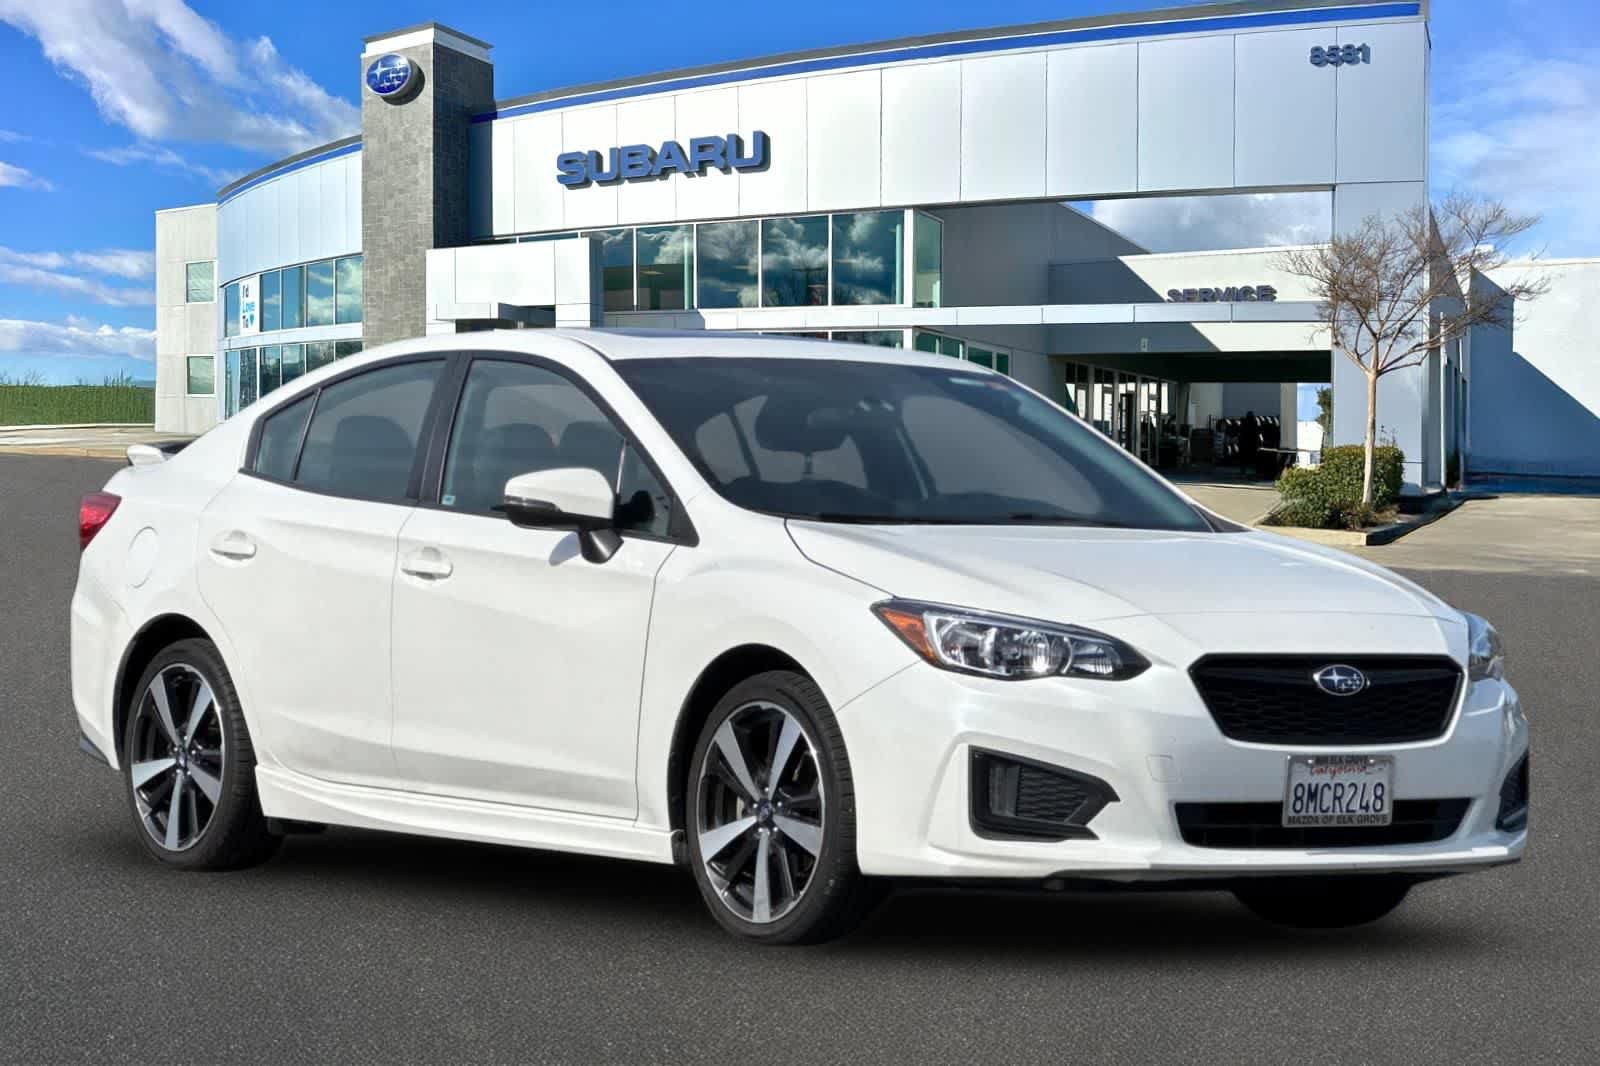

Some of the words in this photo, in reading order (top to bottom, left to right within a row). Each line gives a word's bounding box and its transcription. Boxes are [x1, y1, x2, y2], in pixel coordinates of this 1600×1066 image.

[556, 130, 771, 190] SUBARU
[1167, 284, 1277, 302] SERVICE
[1292, 782, 1385, 814] 8MCR248
[1287, 815, 1319, 825] MAZDA
[1321, 815, 1334, 825] OF
[1336, 815, 1354, 825] ELK
[1357, 814, 1389, 824] GROVE
